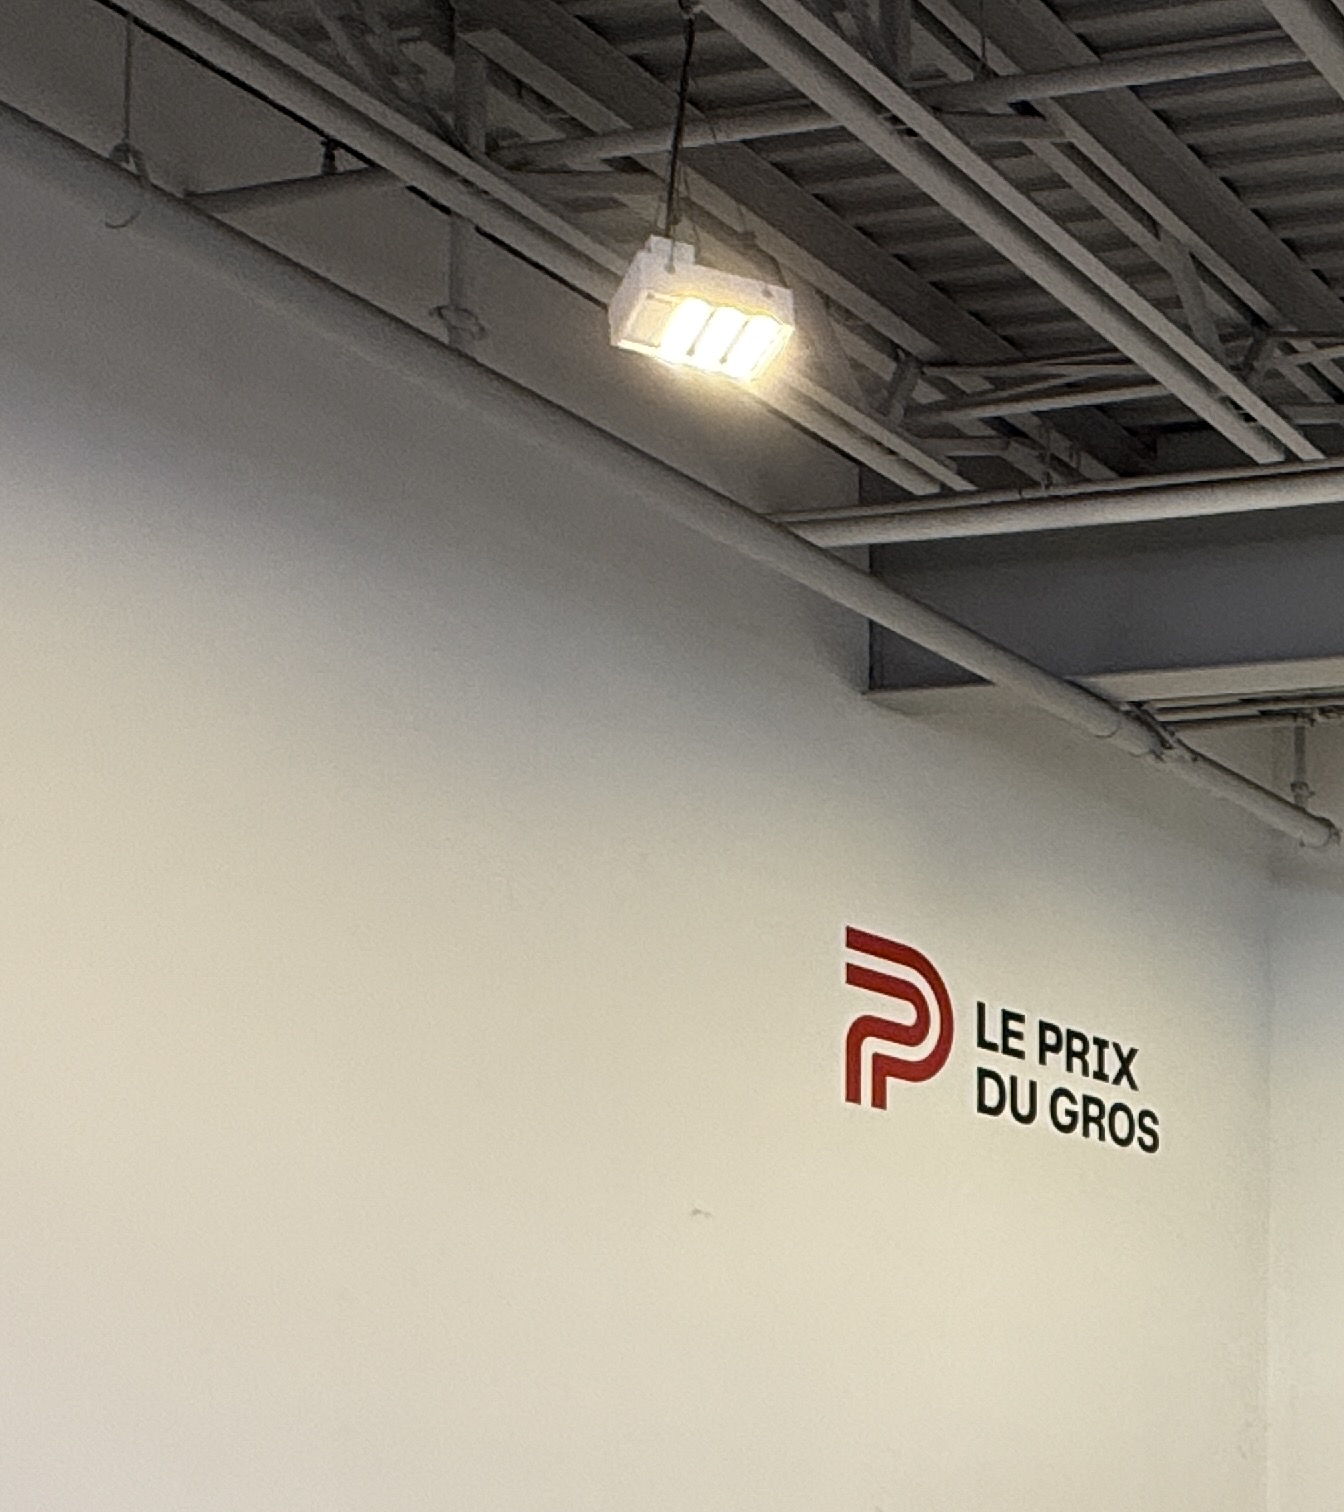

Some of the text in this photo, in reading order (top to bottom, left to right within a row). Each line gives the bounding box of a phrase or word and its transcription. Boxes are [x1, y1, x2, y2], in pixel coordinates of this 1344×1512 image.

[976, 1001, 1140, 1091] LE PRIX
[976, 1066, 1160, 1154] DU GROS
